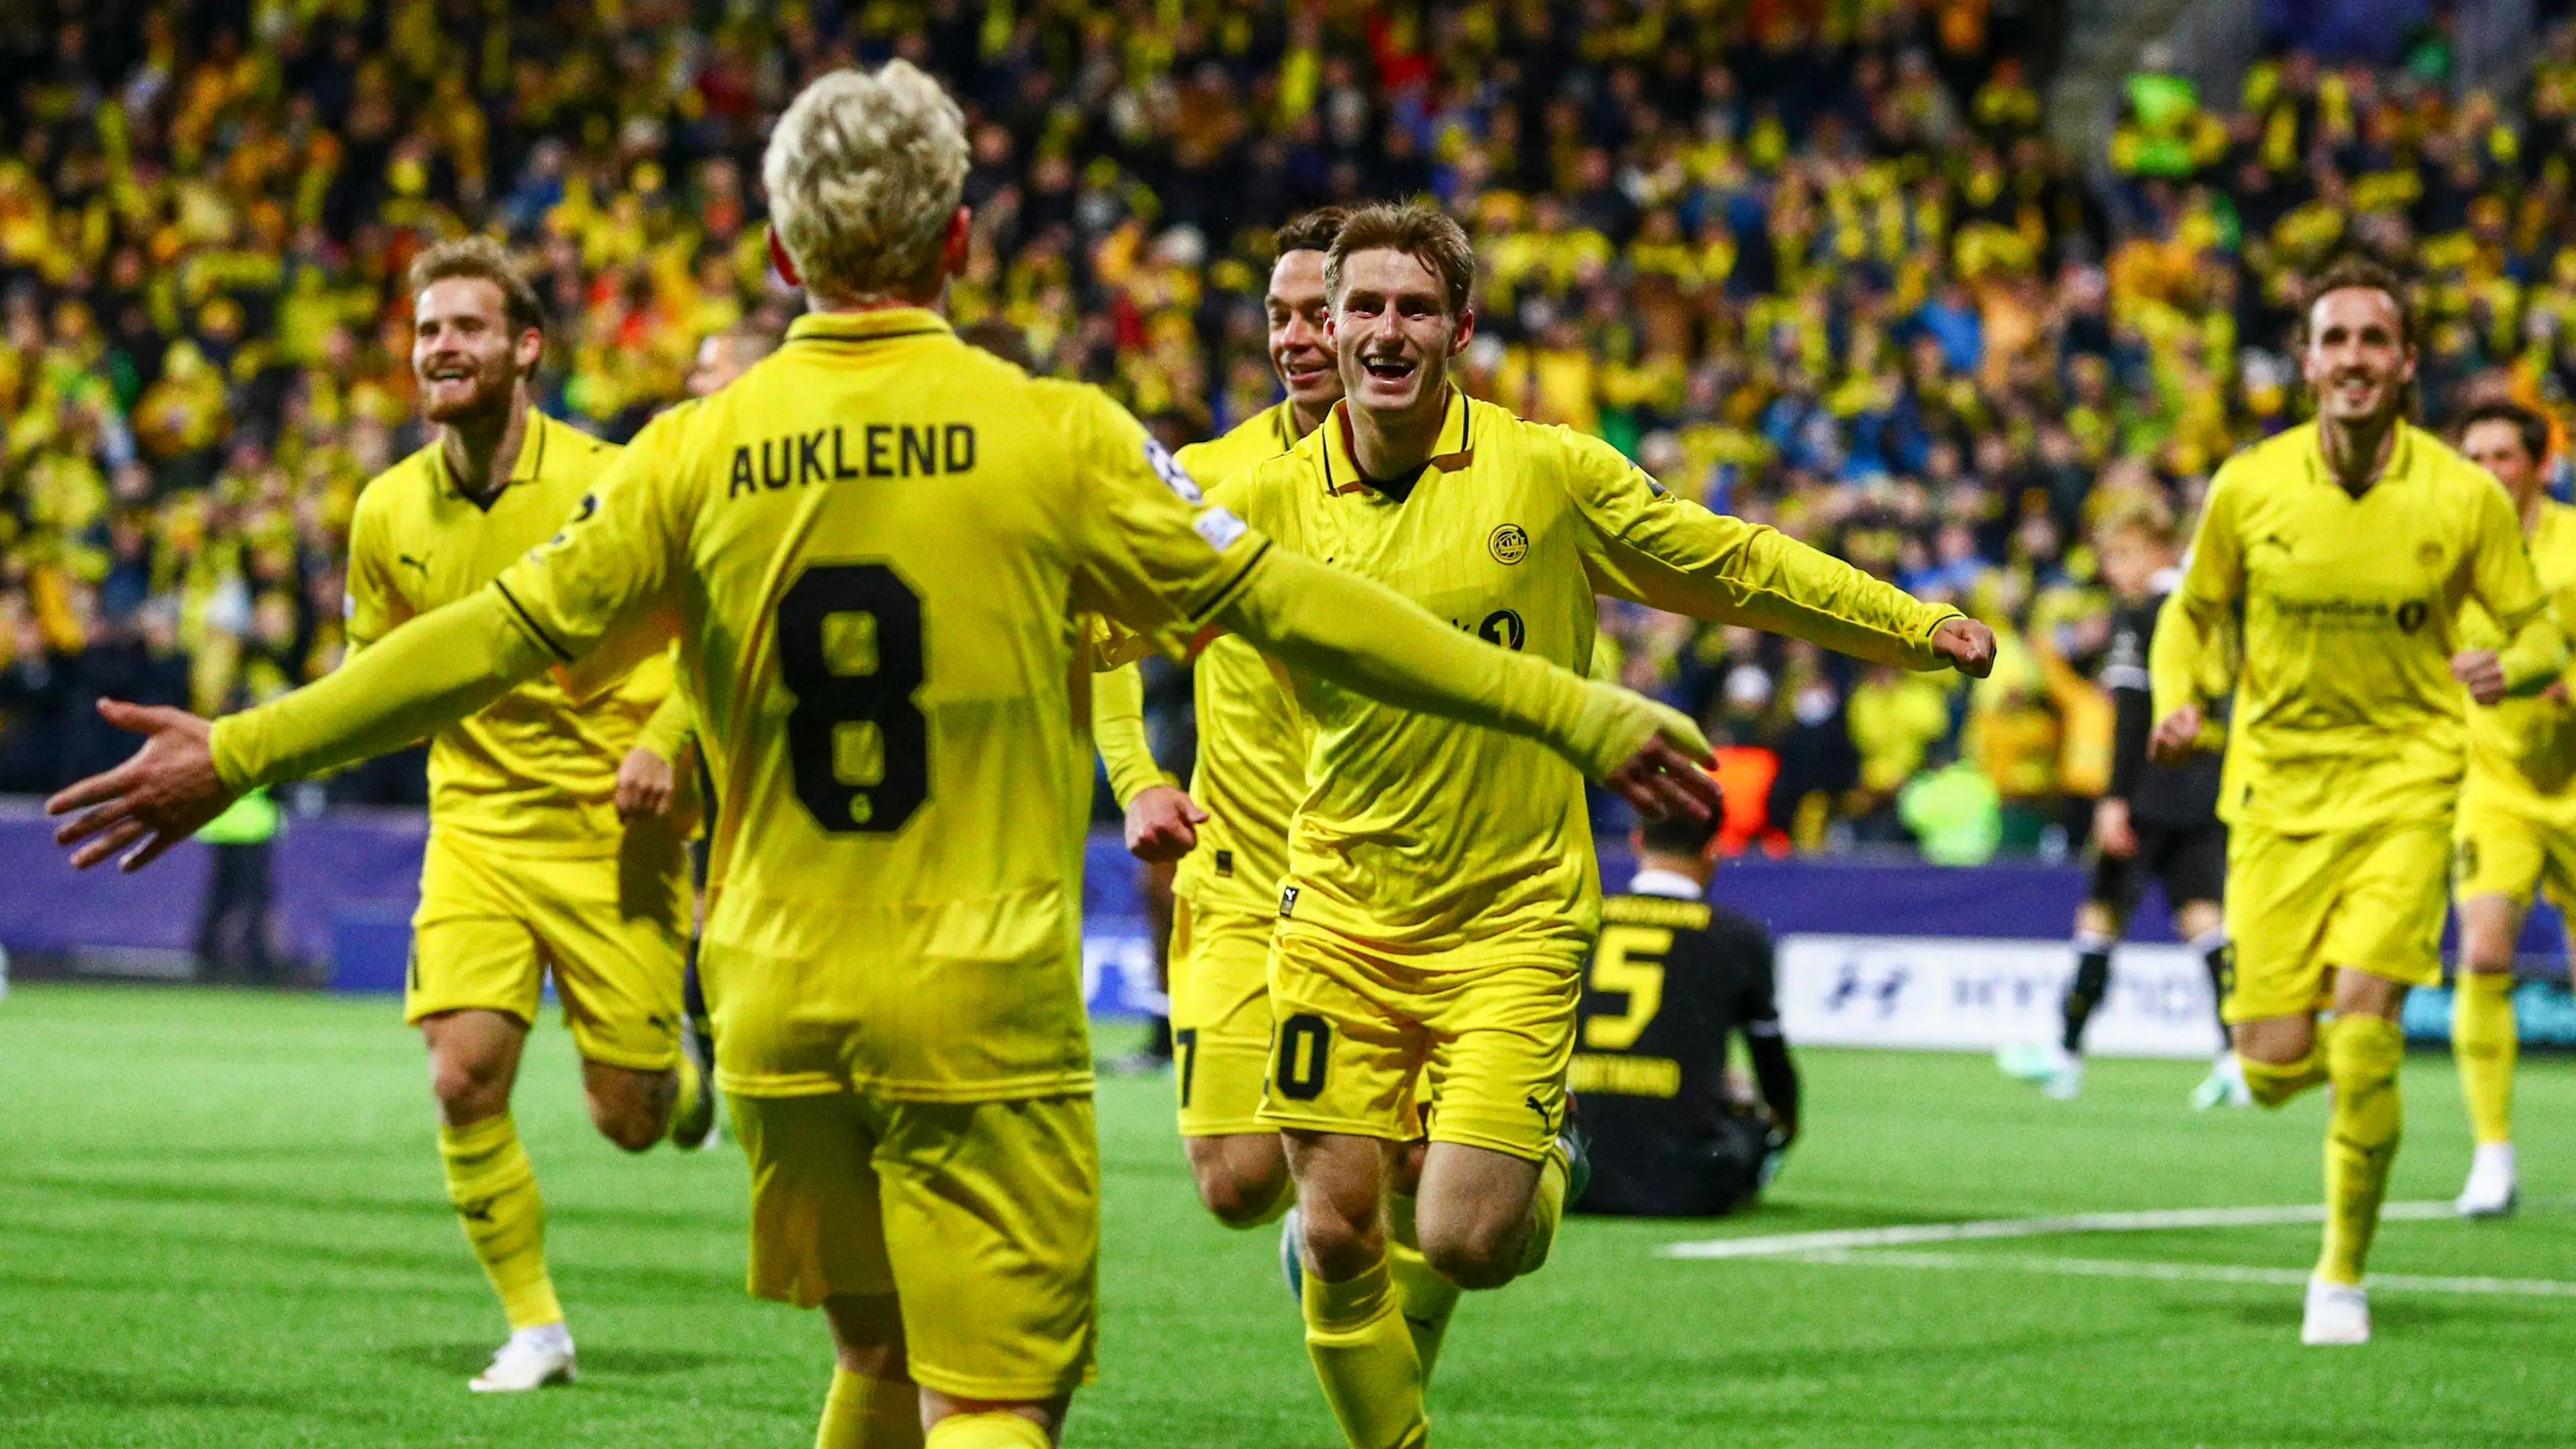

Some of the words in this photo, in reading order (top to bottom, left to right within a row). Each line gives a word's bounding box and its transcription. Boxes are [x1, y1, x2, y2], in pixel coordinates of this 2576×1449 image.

[728, 423, 977, 499] AUKLEND
[778, 563, 929, 833] 8
[1583, 926, 1673, 1049] 5
[1566, 1055, 1682, 1098] ORTMUND
